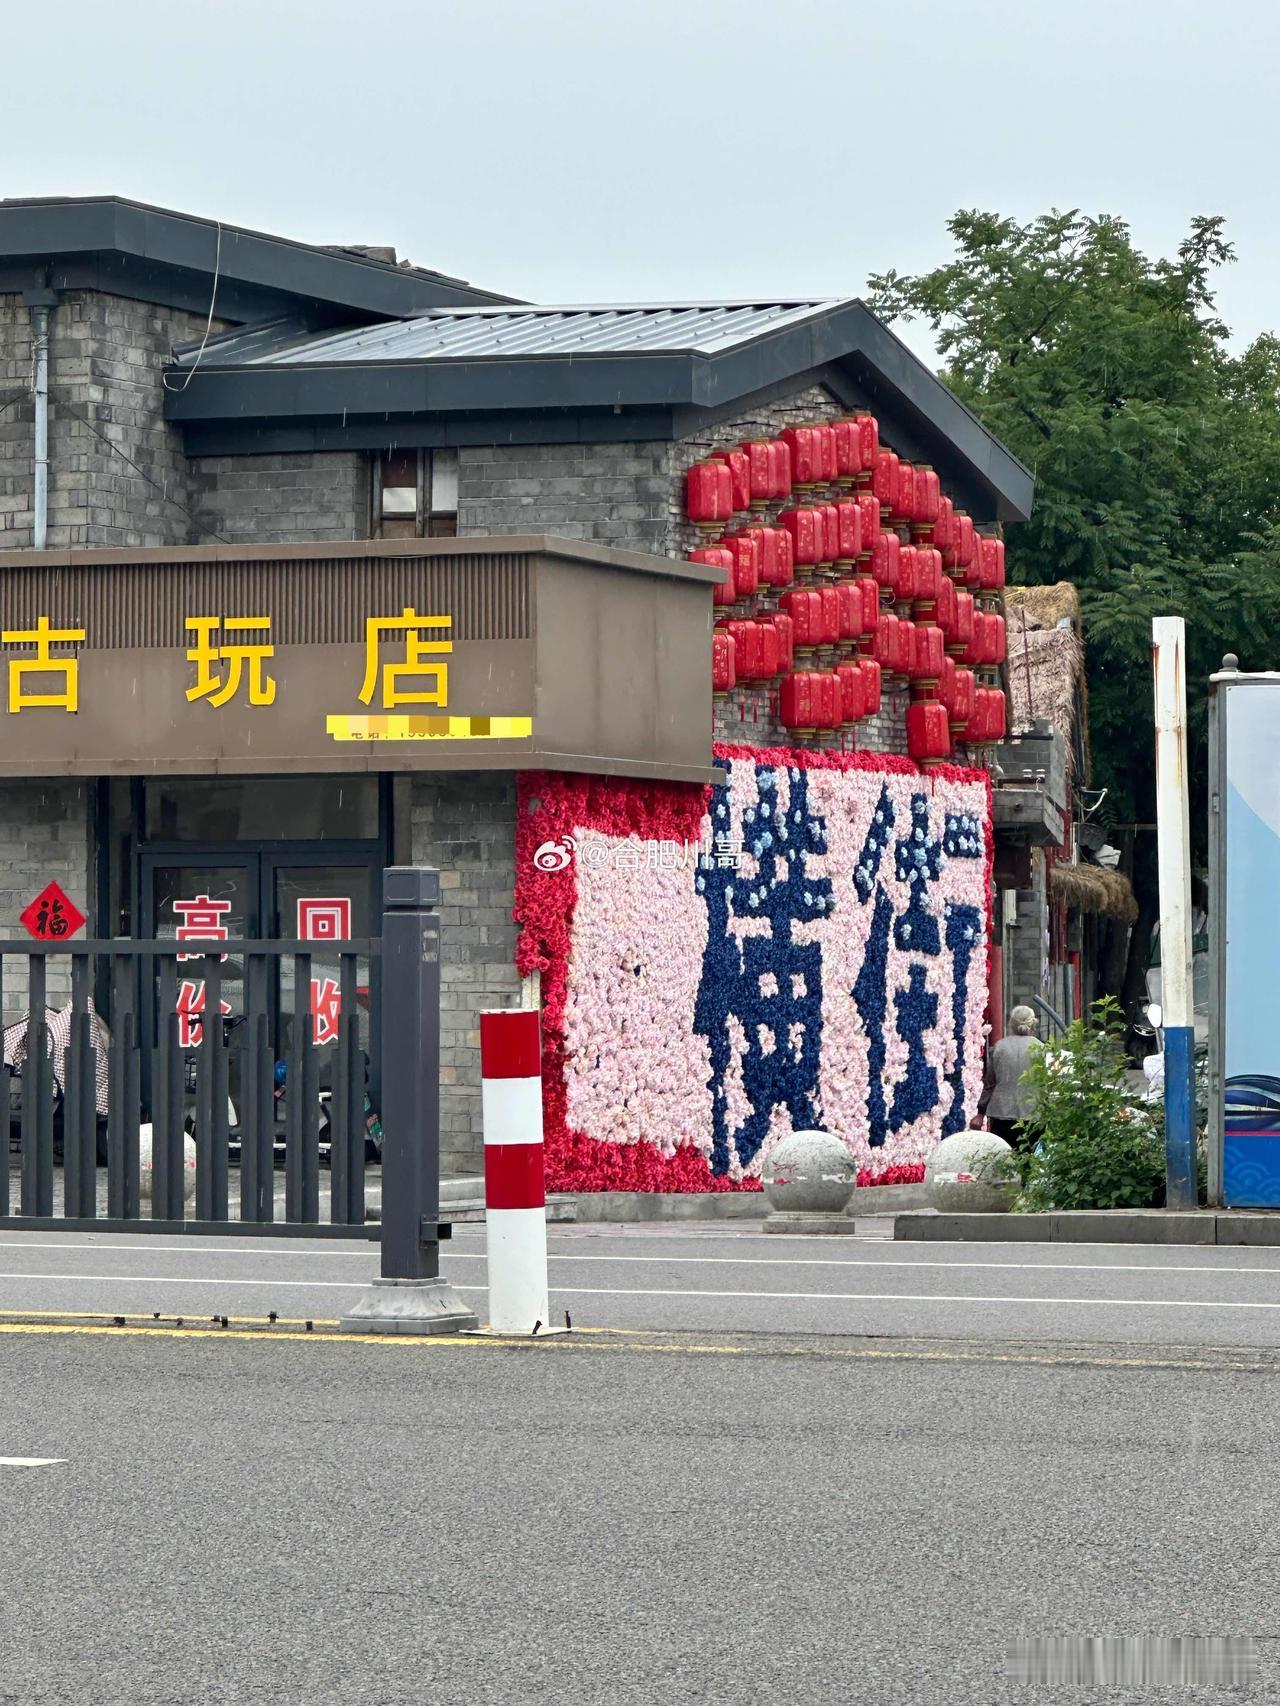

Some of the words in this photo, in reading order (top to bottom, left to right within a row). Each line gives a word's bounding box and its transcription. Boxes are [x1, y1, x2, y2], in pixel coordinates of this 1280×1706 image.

[1, 608, 453, 713] 古玩店
[36, 898, 69, 936] 福
